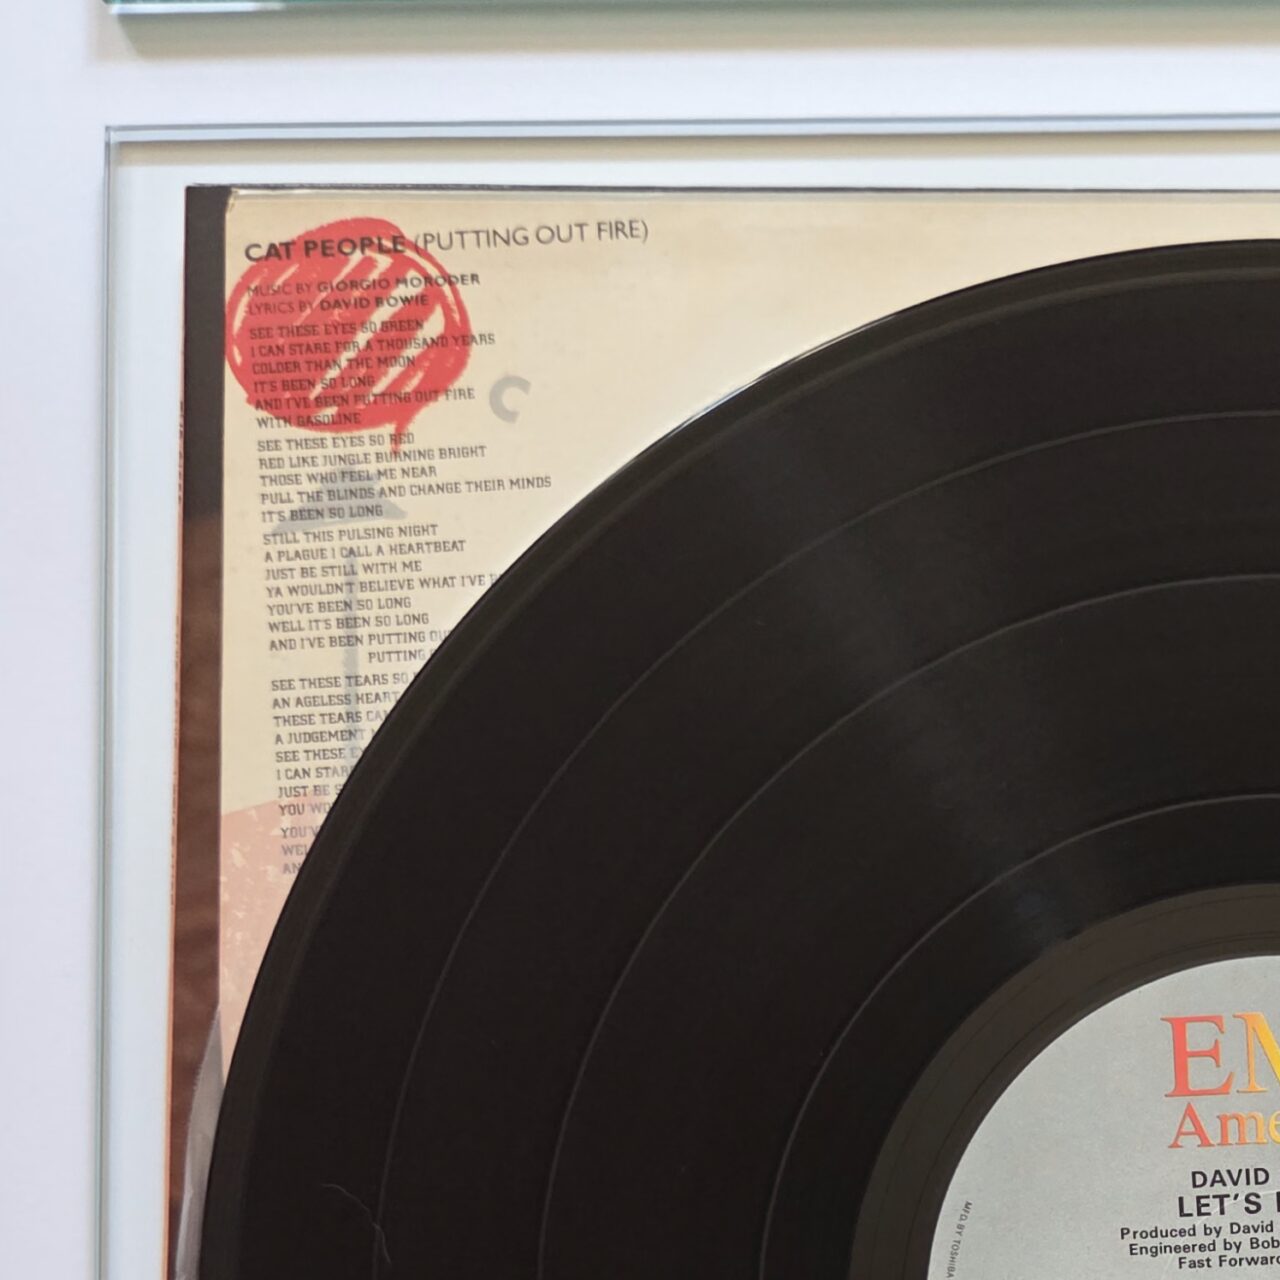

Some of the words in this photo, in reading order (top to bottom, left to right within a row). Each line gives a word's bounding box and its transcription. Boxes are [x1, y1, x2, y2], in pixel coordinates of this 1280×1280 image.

[245, 241, 295, 262] CAT
[304, 235, 406, 258] PEOPLE
[414, 227, 528, 256] (PUTTING
[536, 222, 589, 245] OUT
[597, 219, 648, 244] FIRE)
[247, 283, 293, 297] MUSIC
[296, 282, 313, 294] BY
[317, 278, 390, 293] GIORGIO
[394, 273, 480, 289] MORODER
[250, 302, 294, 316] LYRICS
[299, 300, 314, 312] BY
[319, 296, 370, 311] DAVID
[376, 294, 429, 308] BOWIE
[261, 492, 294, 505] PULL
[298, 490, 323, 503] THE
[327, 487, 375, 501] BLINDS
[379, 485, 406, 498] AND
[410, 482, 461, 496] CHANGE
[465, 478, 505, 493] THEIR
[509, 475, 552, 490] MINDS
[263, 533, 299, 546] STILL
[303, 531, 334, 544] THIS
[339, 527, 394, 541] PULSING
[398, 524, 438, 538] NIGHT
[1191, 1168, 1269, 1189] DAVID
[1178, 1192, 1262, 1217] LET'S
[1120, 1224, 1196, 1240] Produced
[1204, 1224, 1222, 1238] by
[1230, 1220, 1273, 1234] David
[1129, 1239, 1216, 1258] Engineered
[1223, 1238, 1242, 1254] by
[1250, 1236, 1280, 1249] Bob
[1179, 1257, 1212, 1269] Fast
